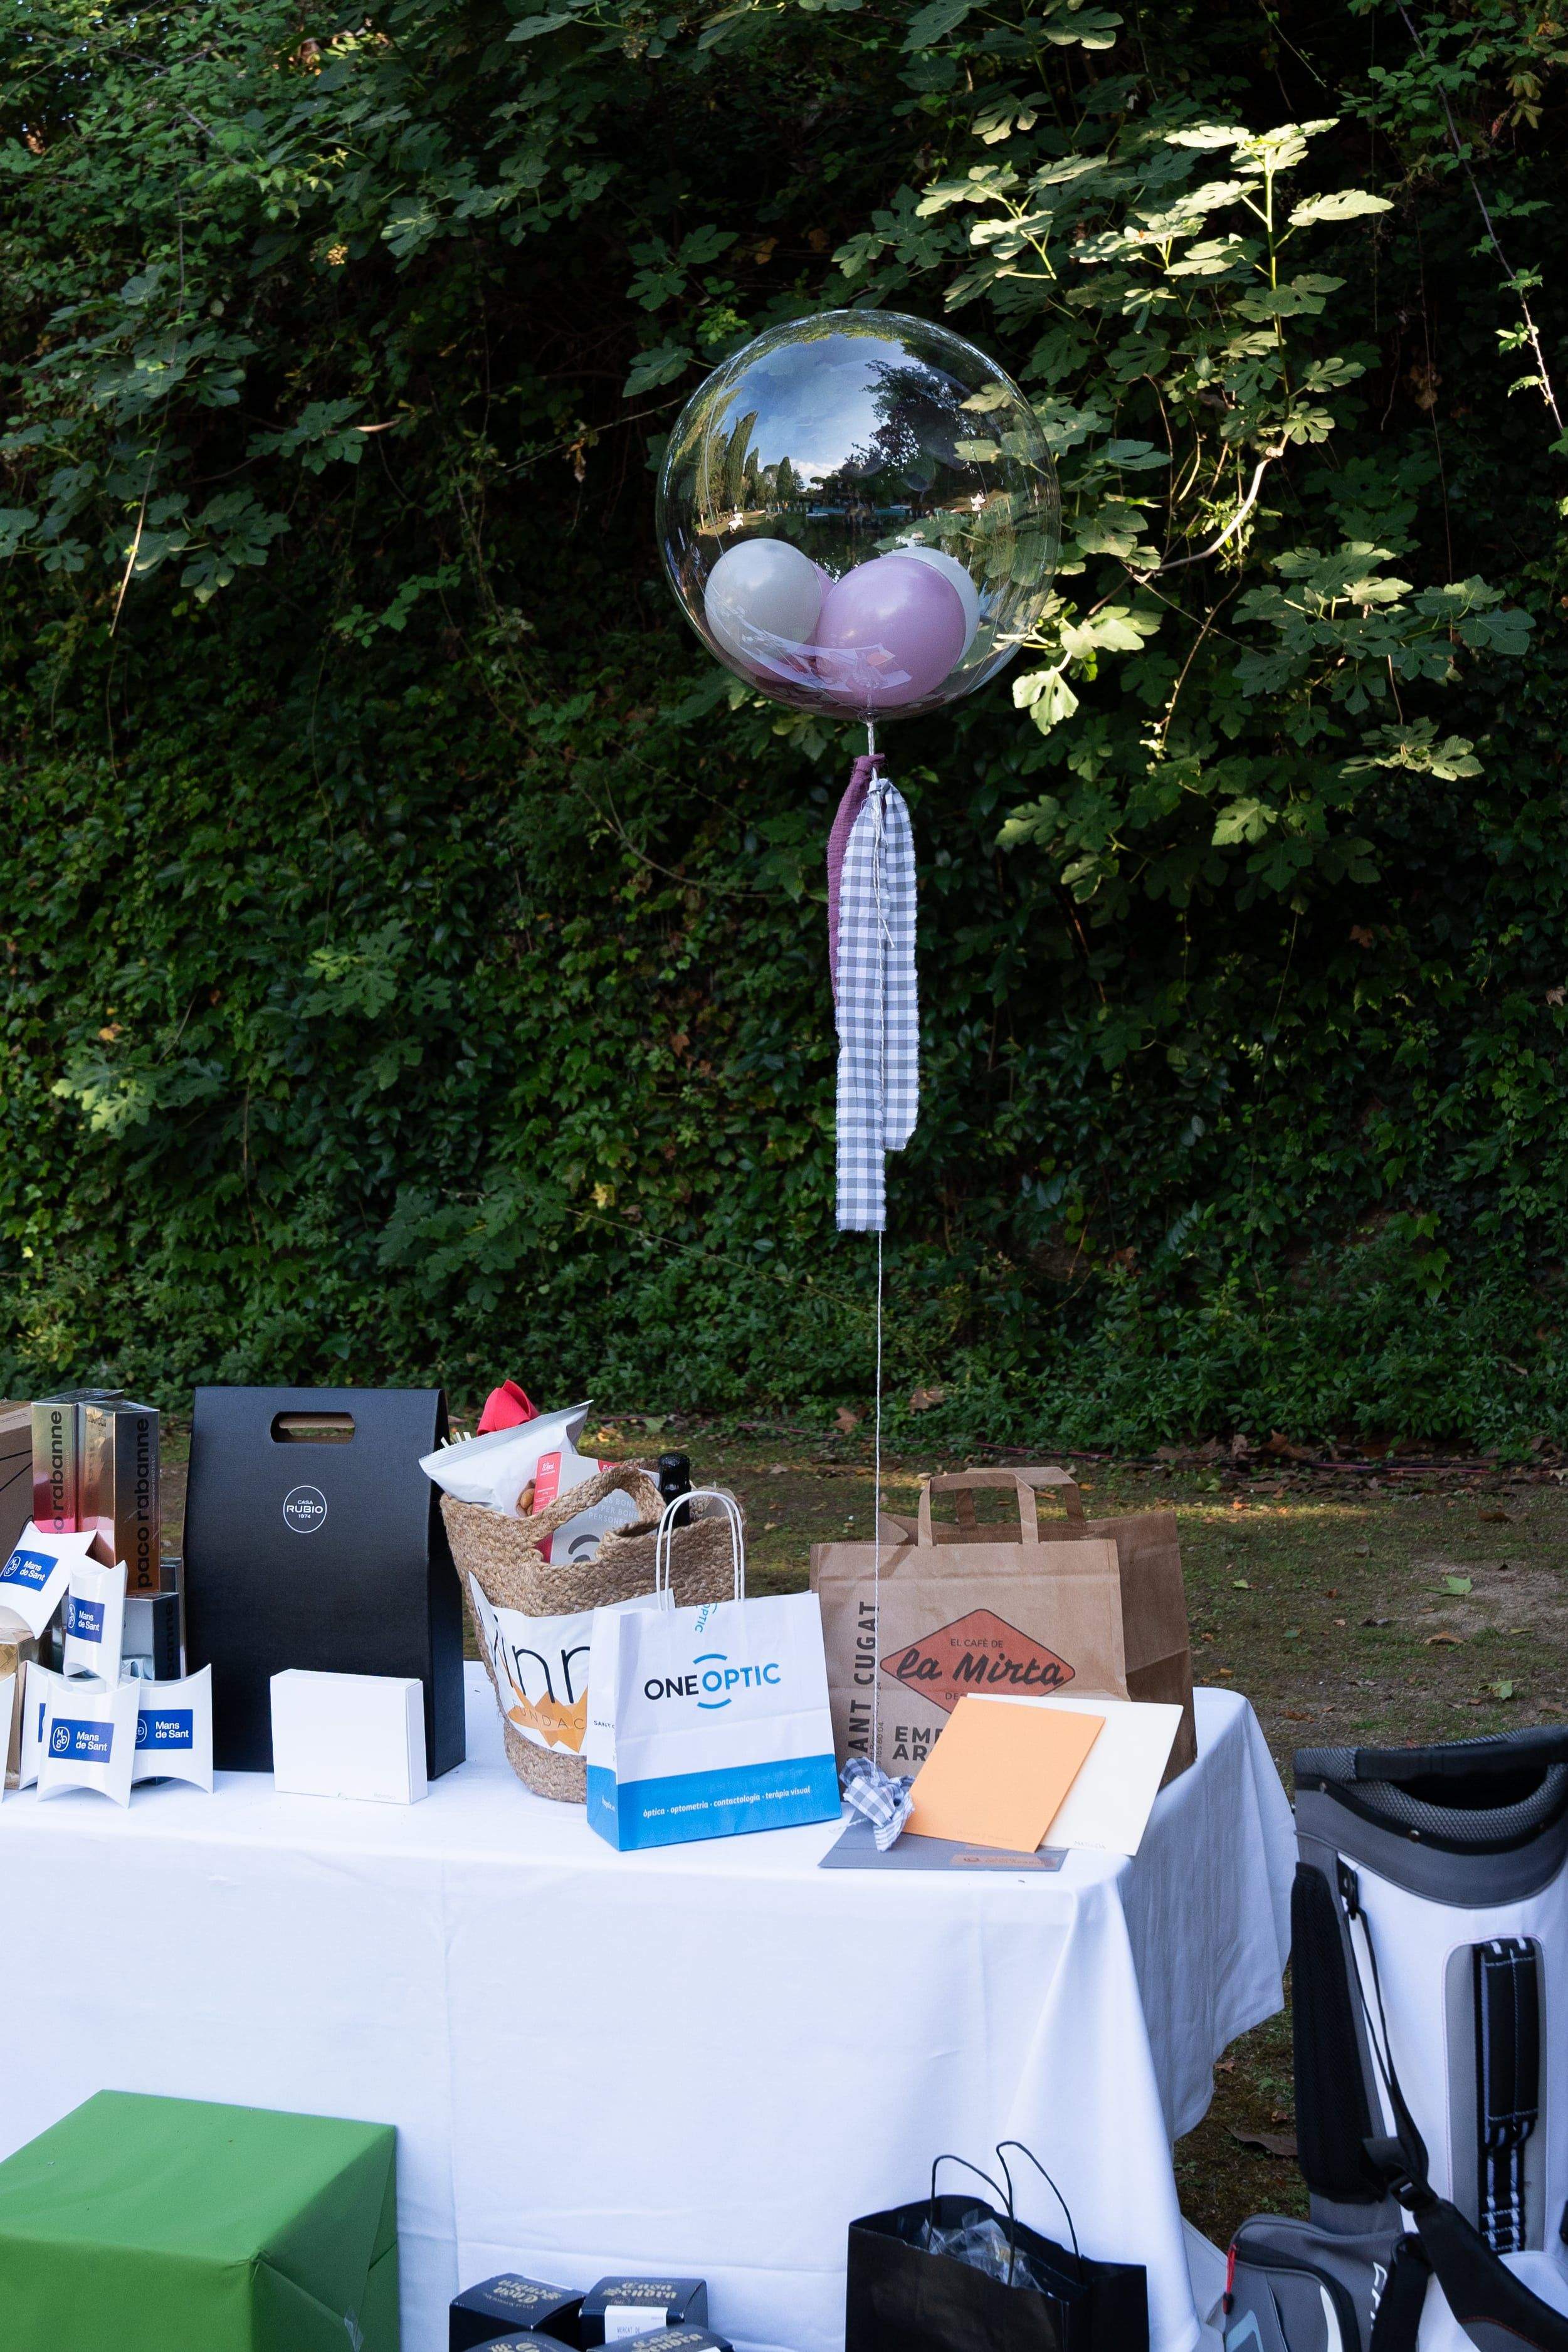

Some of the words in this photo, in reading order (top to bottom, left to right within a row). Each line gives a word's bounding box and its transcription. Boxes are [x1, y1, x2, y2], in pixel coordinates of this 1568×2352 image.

[50, 1411, 64, 1511] rabanne
[134, 1418, 150, 1521] rabanne
[287, 1505, 324, 1514] RUBIO
[616, 1499, 636, 1509] BONE
[618, 1509, 638, 1519] BONE
[137, 1526, 152, 1588] paco
[23, 1560, 42, 1571] Mans
[29, 1569, 46, 1581] Sant
[79, 1610, 94, 1621] Mans
[86, 1622, 100, 1632] Sant
[853, 1601, 879, 1685] CUGAT
[950, 1638, 960, 1647] EL
[964, 1637, 989, 1647] CAFÈ
[991, 1640, 1003, 1648] DE
[896, 1647, 942, 1680] la
[952, 1652, 1065, 1685] Mirta
[512, 1698, 585, 1729] FUNDAC
[155, 1721, 180, 1730] Mans
[848, 1699, 871, 1754] ANT
[76, 1731, 100, 1741] Mans
[155, 1730, 167, 1739] de
[168, 1729, 189, 1739] Sant
[75, 1741, 87, 1749] de
[87, 1741, 107, 1752] Sant
[892, 1744, 927, 1761] AR
[643, 1808, 665, 1818] òptica
[670, 1802, 708, 1815] optometria
[713, 1793, 760, 1806] contactologia
[766, 1789, 789, 1800] teràpia
[791, 1786, 811, 1795] visual
